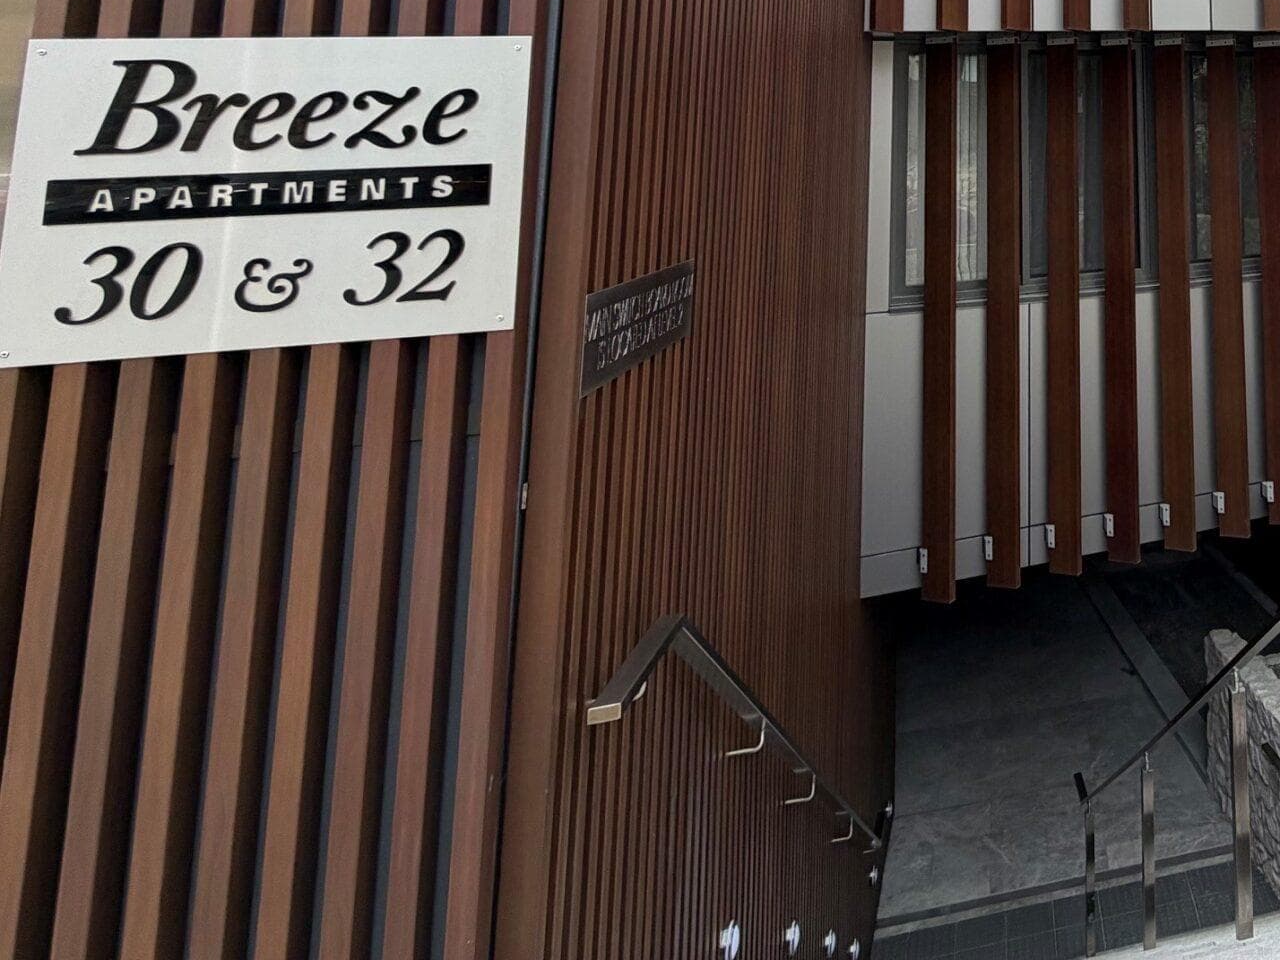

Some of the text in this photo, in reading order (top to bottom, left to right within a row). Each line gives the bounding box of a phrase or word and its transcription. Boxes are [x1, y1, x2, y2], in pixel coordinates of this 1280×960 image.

[73, 58, 480, 156] Breeze
[88, 174, 457, 213] APARTMENTS
[54, 228, 466, 325] 30 & 32
